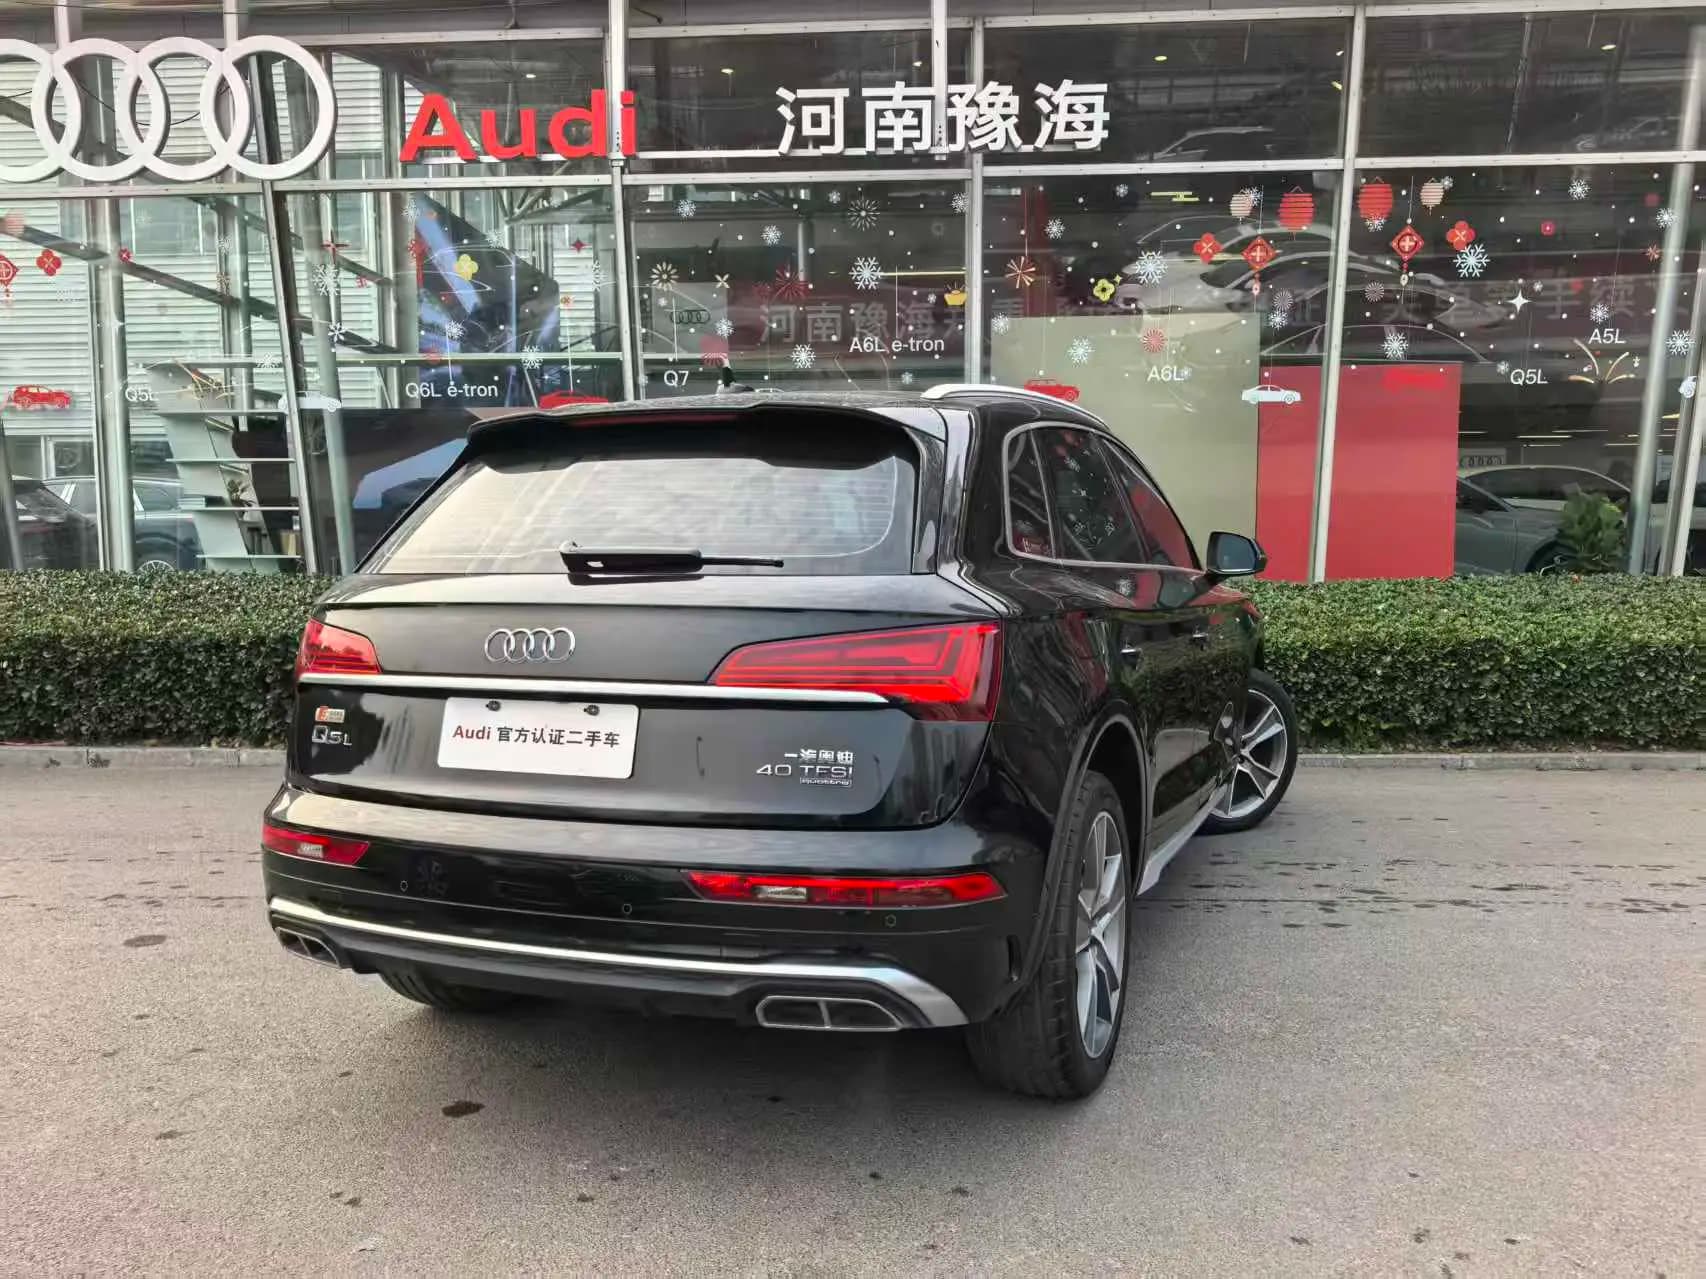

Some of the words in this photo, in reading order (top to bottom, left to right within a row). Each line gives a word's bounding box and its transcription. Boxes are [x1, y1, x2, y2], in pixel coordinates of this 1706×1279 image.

[400, 88, 637, 163] Audi
[775, 79, 1111, 156] 河南豫海
[849, 336, 886, 353] A6L
[891, 337, 945, 352] e-tron
[1588, 328, 1626, 344] A5L
[663, 370, 689, 387] Q7
[1147, 365, 1185, 382] A6L
[1510, 368, 1549, 386] Q5L
[405, 382, 442, 399] Q6L
[447, 383, 498, 398] e-tron
[311, 725, 353, 746] Q5L
[452, 725, 492, 740] Audi
[497, 726, 620, 748] 官方认证二手车
[756, 764, 792, 776] 40
[799, 765, 853, 778] TFSI
